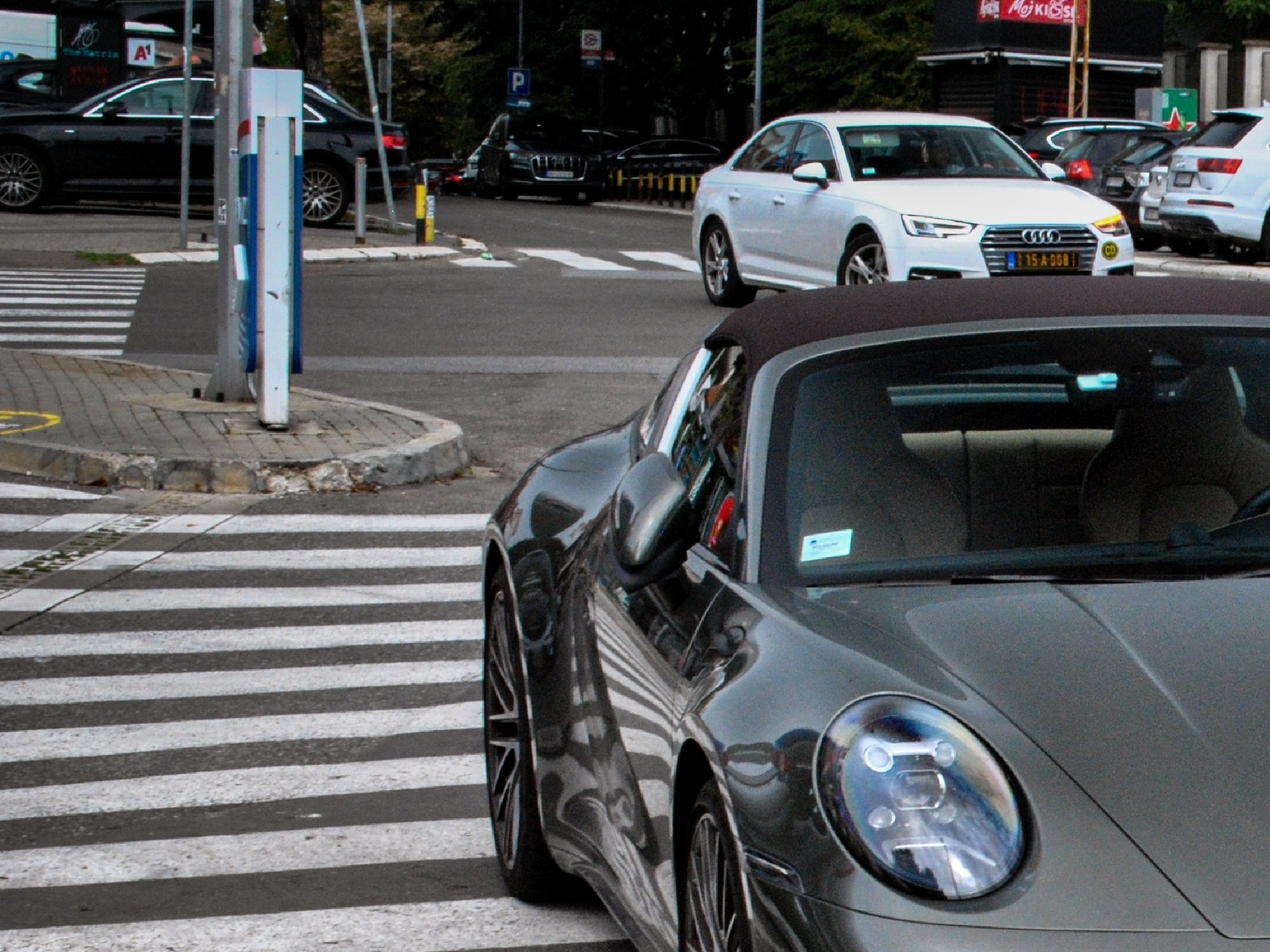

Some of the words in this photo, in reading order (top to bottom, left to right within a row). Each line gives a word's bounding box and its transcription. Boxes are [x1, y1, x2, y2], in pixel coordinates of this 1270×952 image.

[134, 43, 152, 61] A1
[512, 71, 525, 92] P
[1104, 245, 1117, 256] CD
